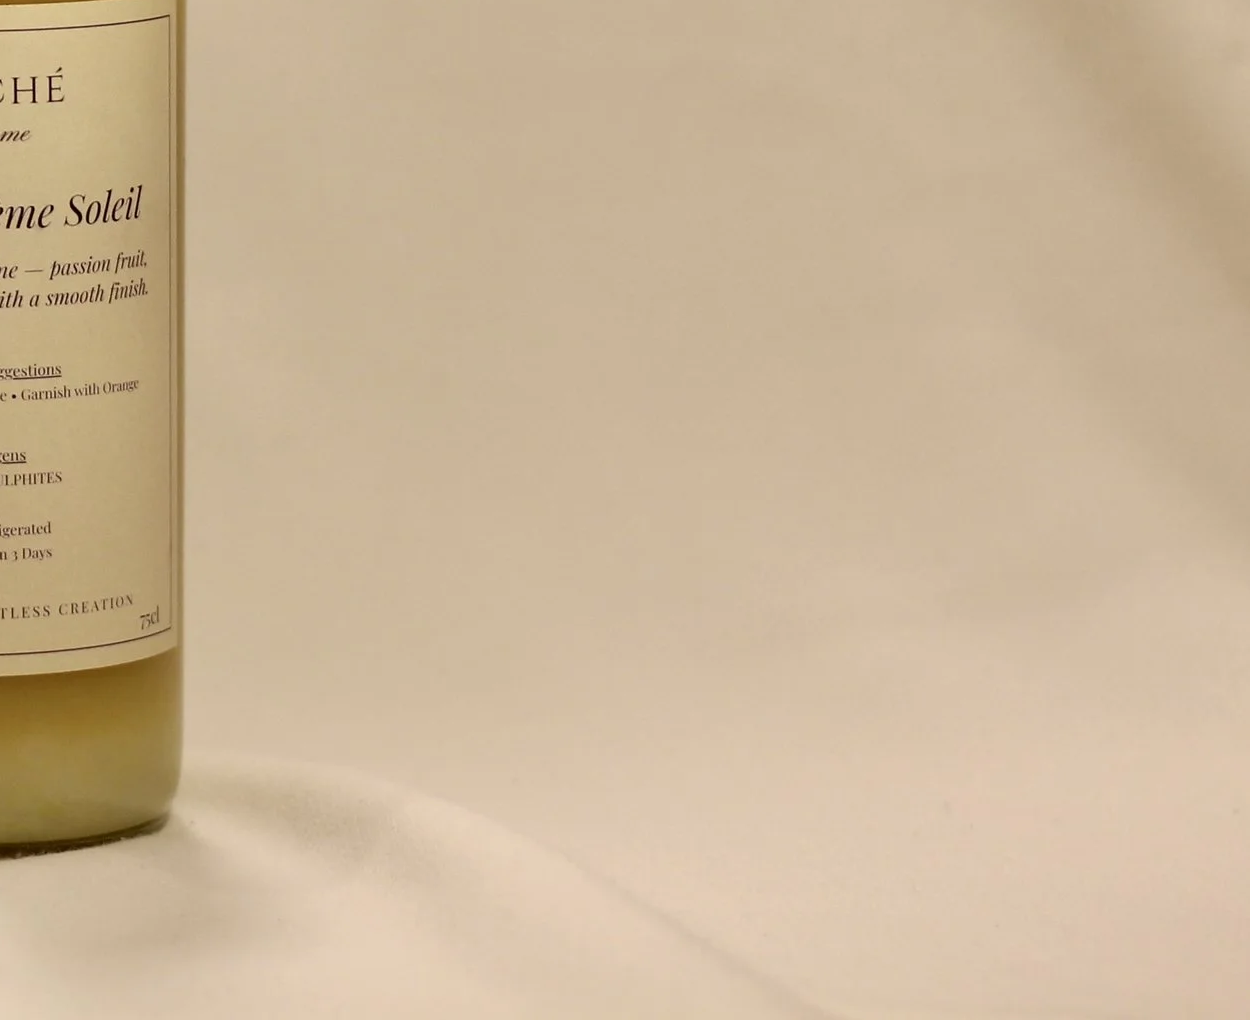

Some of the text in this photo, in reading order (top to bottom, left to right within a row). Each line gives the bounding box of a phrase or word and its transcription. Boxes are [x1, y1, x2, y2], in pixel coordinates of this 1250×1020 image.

[63, 184, 143, 227] Soleil
[48, 257, 111, 281] passion
[114, 249, 148, 275] fruit,
[28, 294, 40, 308] a
[44, 285, 105, 307] smooth
[108, 277, 149, 305] finish.
[20, 385, 72, 402] Garnish
[73, 382, 100, 398] with
[102, 379, 139, 396] Orange
[11, 550, 19, 563] 3
[21, 547, 53, 563] Days
[57, 593, 135, 617] CREATION
[139, 605, 161, 631] 75cl
